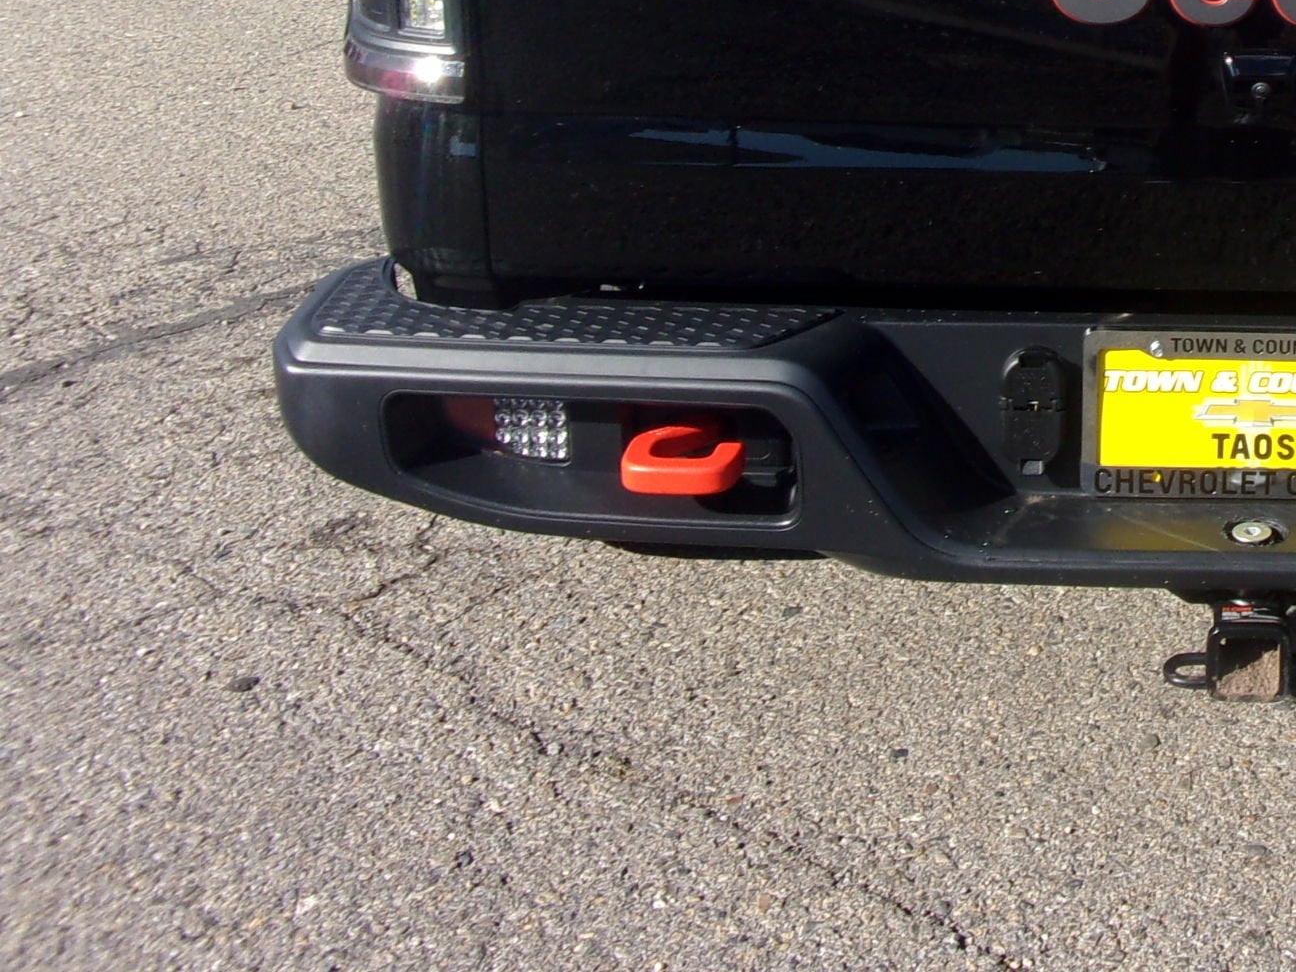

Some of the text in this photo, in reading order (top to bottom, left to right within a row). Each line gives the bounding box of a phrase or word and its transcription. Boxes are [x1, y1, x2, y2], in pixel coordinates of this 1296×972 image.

[1171, 337, 1228, 354] TOWN
[1233, 339, 1247, 354] &
[1103, 369, 1205, 394] TOWN
[1210, 369, 1240, 394] &
[1211, 433, 1296, 461] TAOS
[1094, 468, 1277, 496] CHEVROLET
